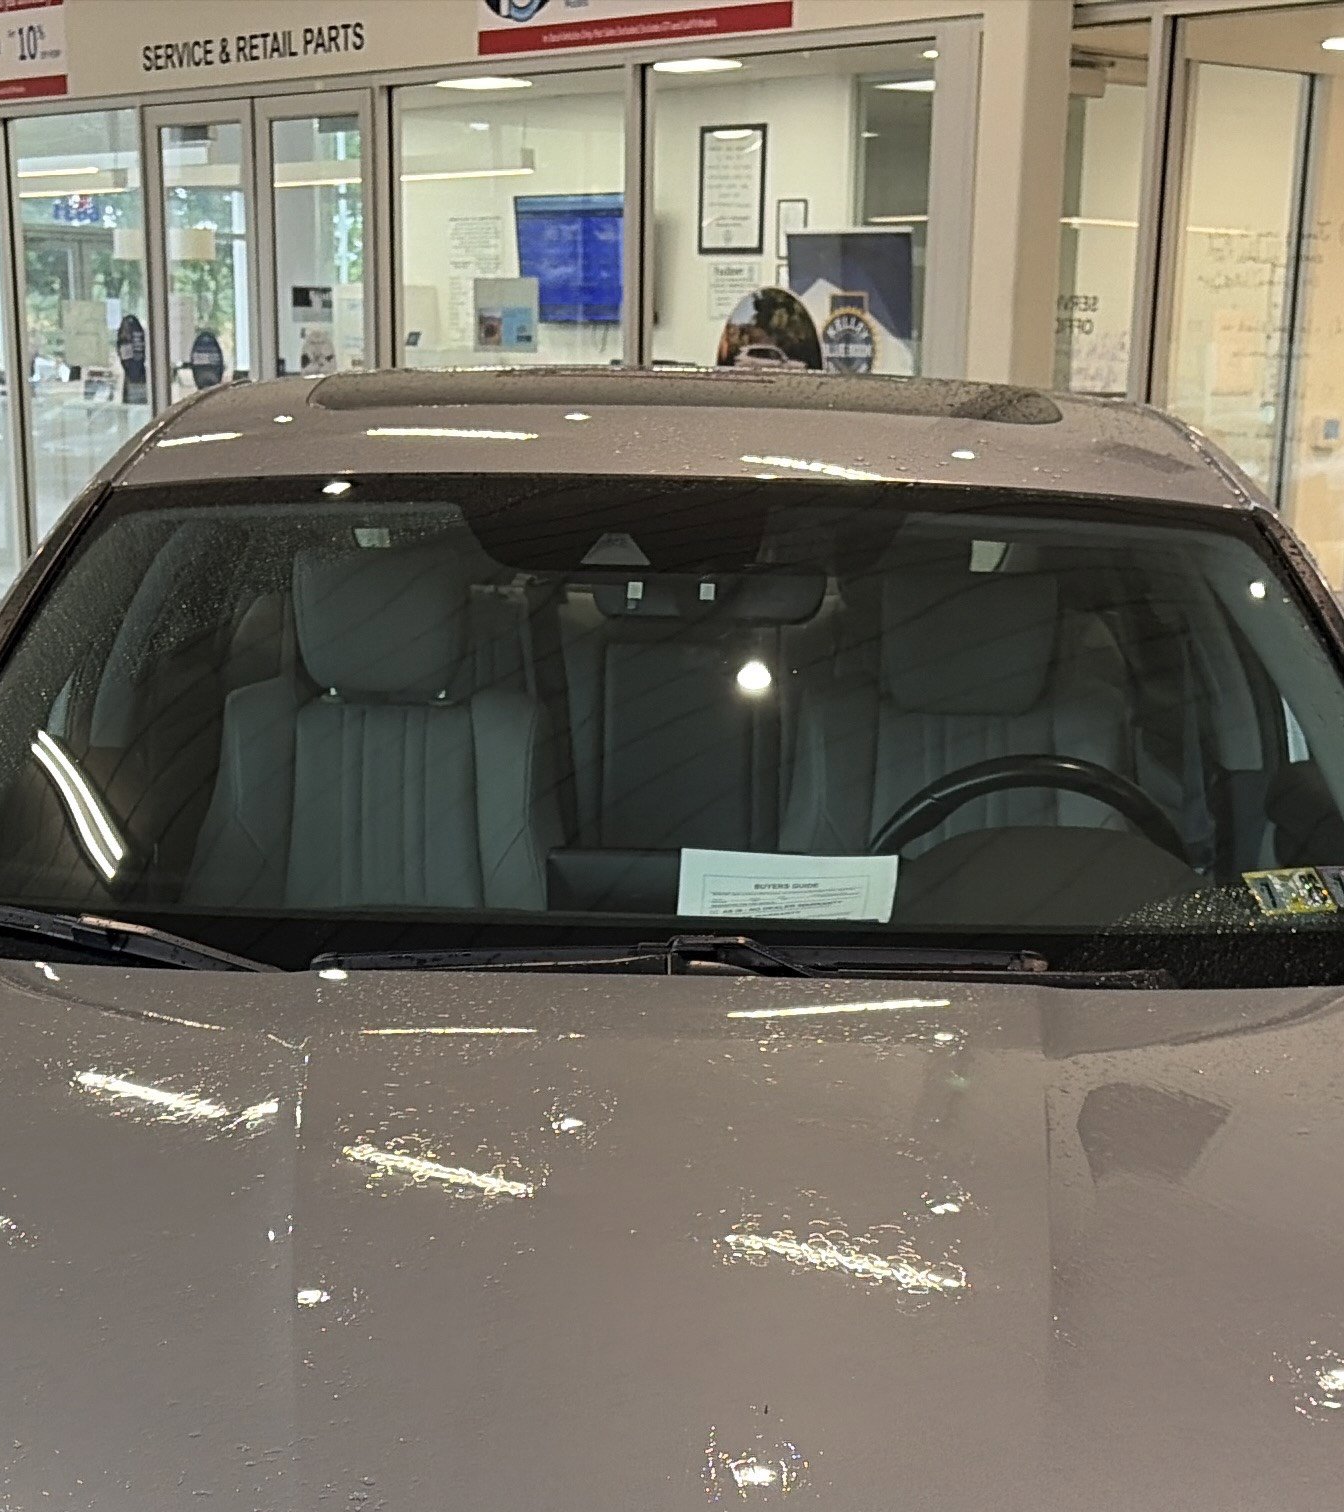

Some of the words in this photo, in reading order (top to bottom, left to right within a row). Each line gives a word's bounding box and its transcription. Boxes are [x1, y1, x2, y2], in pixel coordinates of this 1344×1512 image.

[142, 39, 214, 71] SERVICE
[219, 37, 231, 64] &
[236, 30, 298, 62] RETAIL
[303, 22, 365, 55] PARTS
[792, 882, 819, 890] GUIDE
